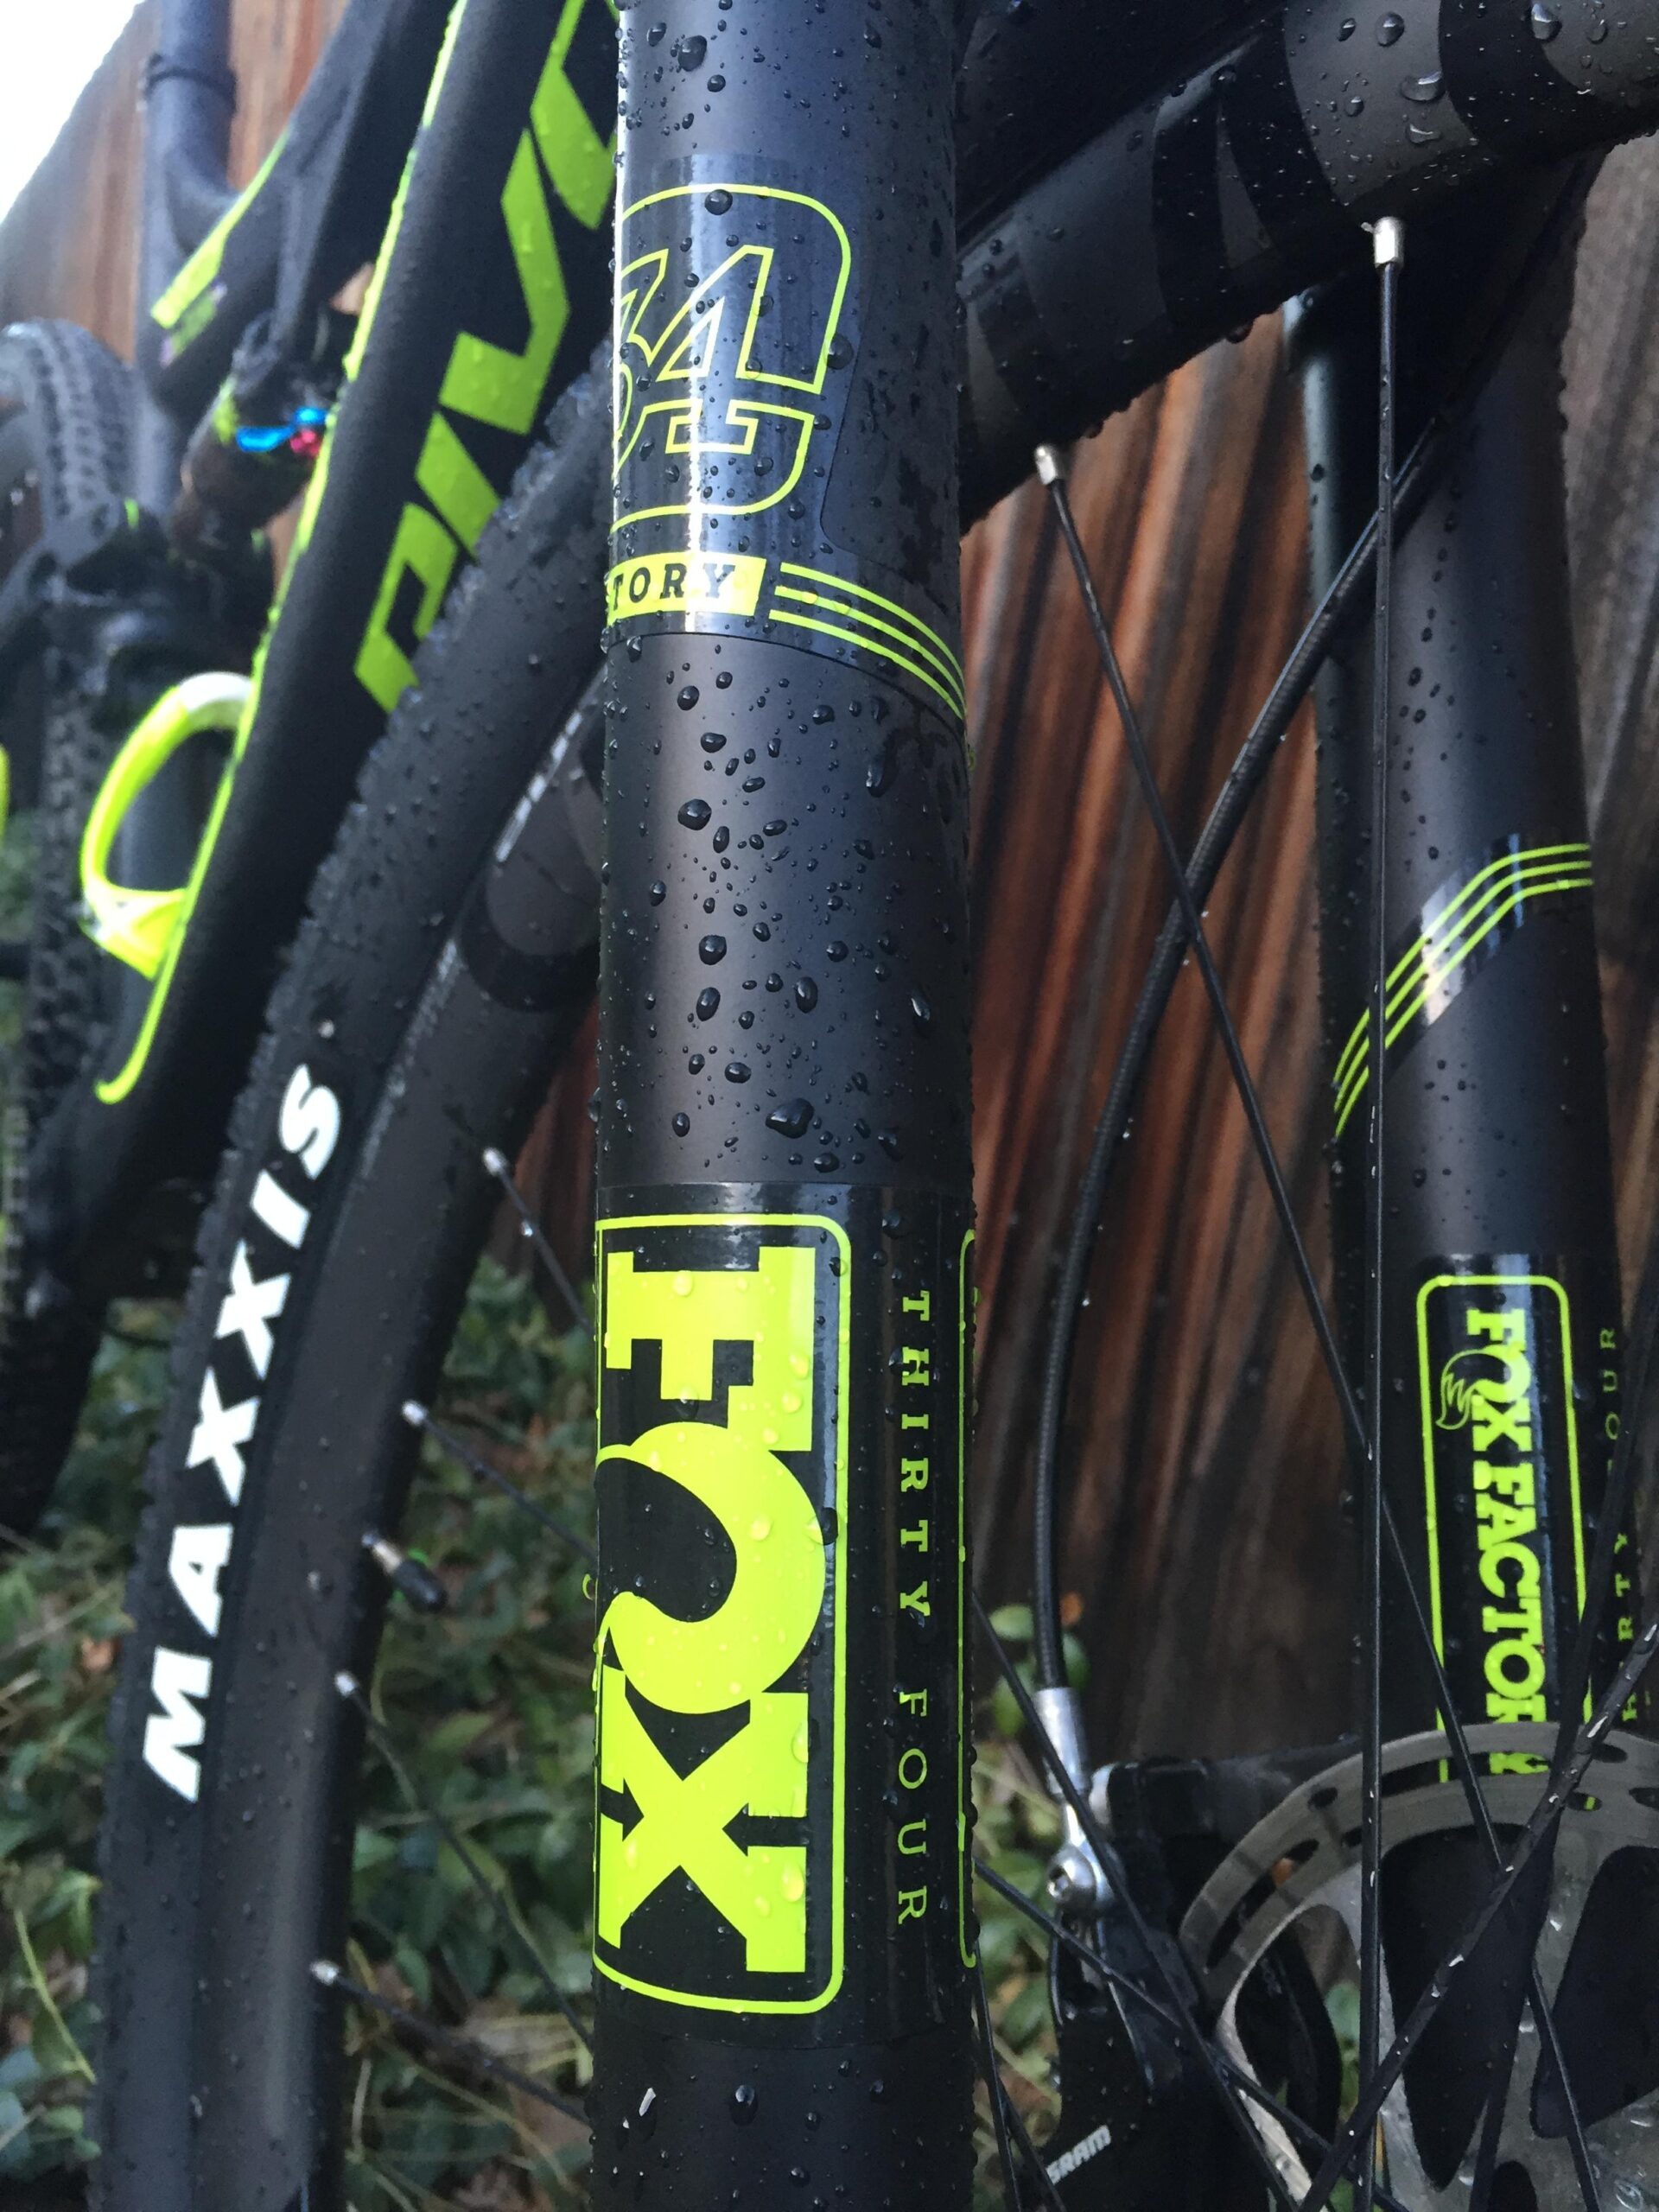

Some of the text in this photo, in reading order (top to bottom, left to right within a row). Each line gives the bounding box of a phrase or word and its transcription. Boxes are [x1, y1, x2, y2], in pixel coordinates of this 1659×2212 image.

[143, 1063, 341, 1802] MAXXIS
[596, 1245, 827, 1973] FOX
[897, 1289, 931, 1925] THIRTY FOUR
[1436, 1308, 1534, 1452] FOX
[1599, 1327, 1621, 1476] OUR
